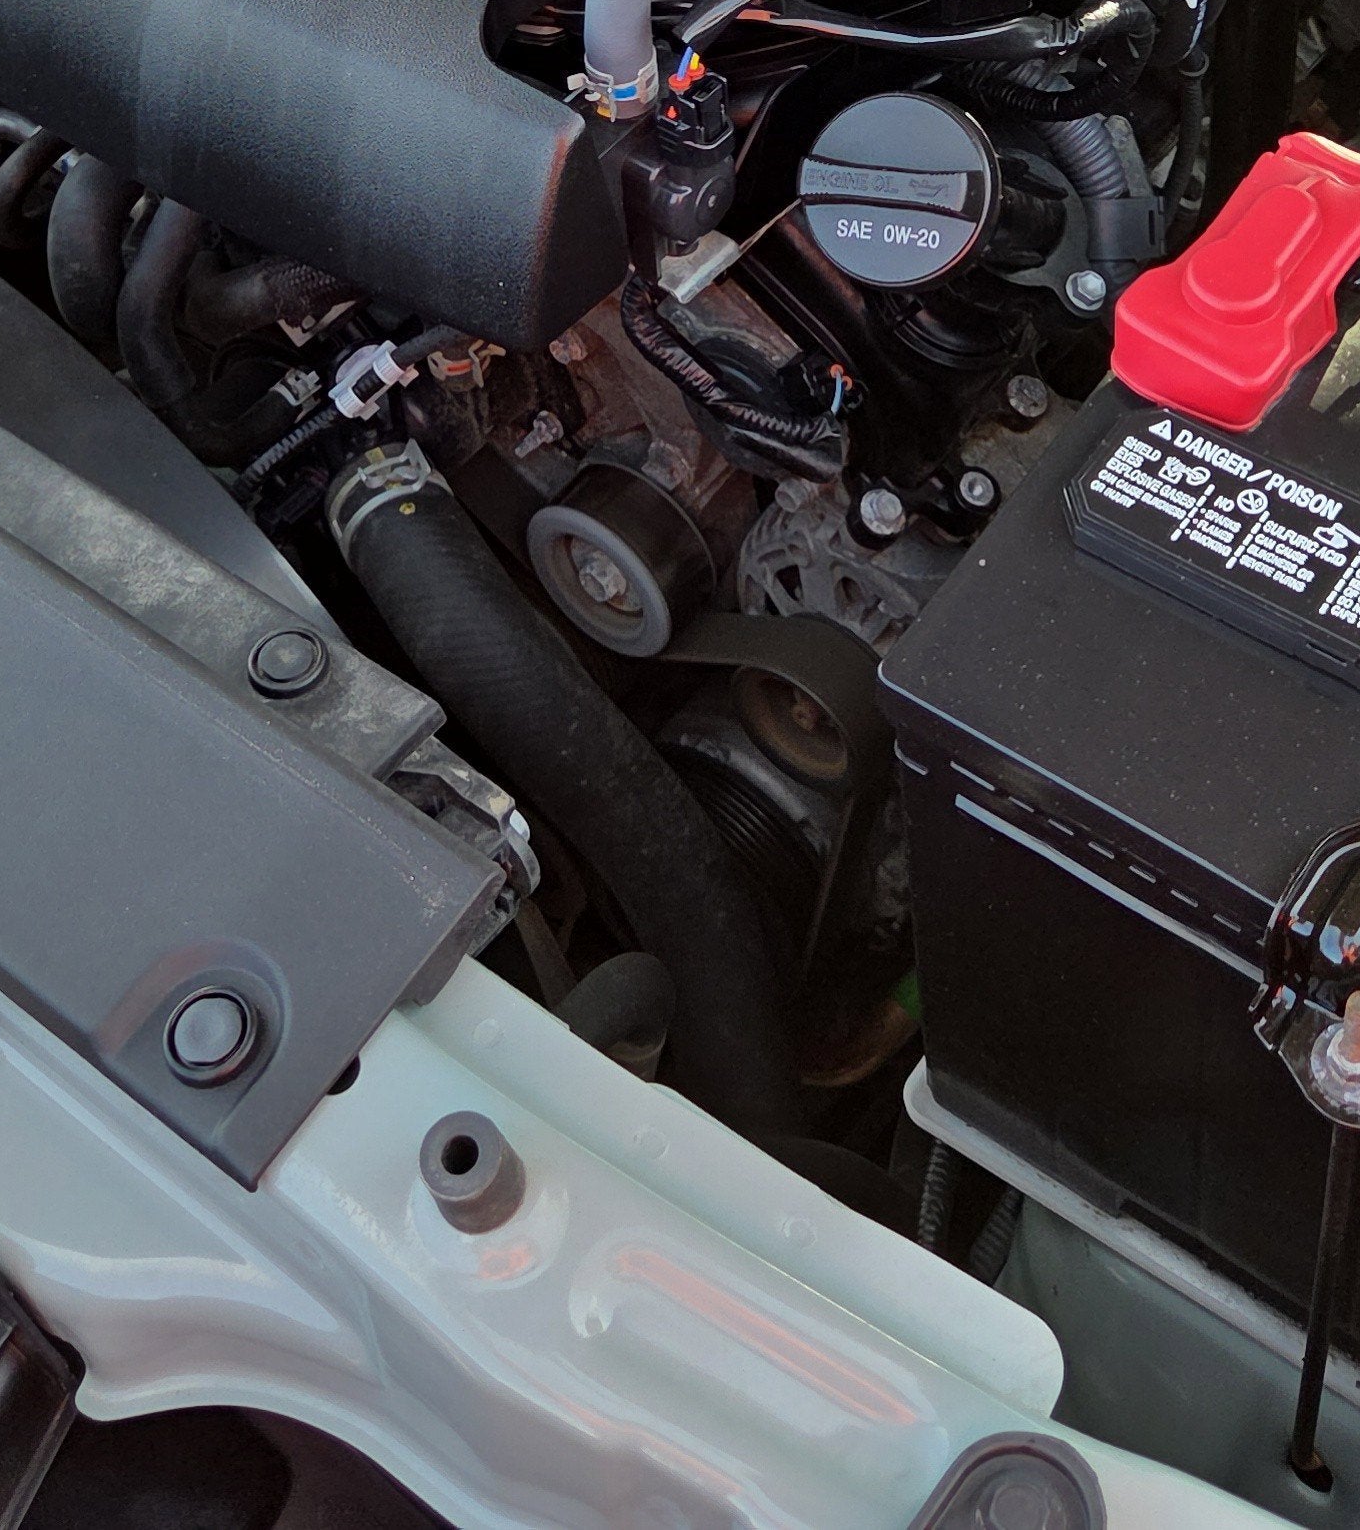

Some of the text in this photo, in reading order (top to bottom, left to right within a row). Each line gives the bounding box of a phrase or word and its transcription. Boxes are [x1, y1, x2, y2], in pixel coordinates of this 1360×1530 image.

[836, 219, 940, 249] SAE 0W-20
[1114, 446, 1144, 468] EYES
[1120, 436, 1161, 461] SHIELD
[1098, 469, 1118, 485] CAN
[1116, 479, 1144, 499] CAUSE
[1104, 458, 1196, 508] EXPLOSIVE GASES
[1214, 496, 1234, 512] NO
[1254, 534, 1276, 550] CAN
[1263, 520, 1346, 566] SULFURIC ACID
